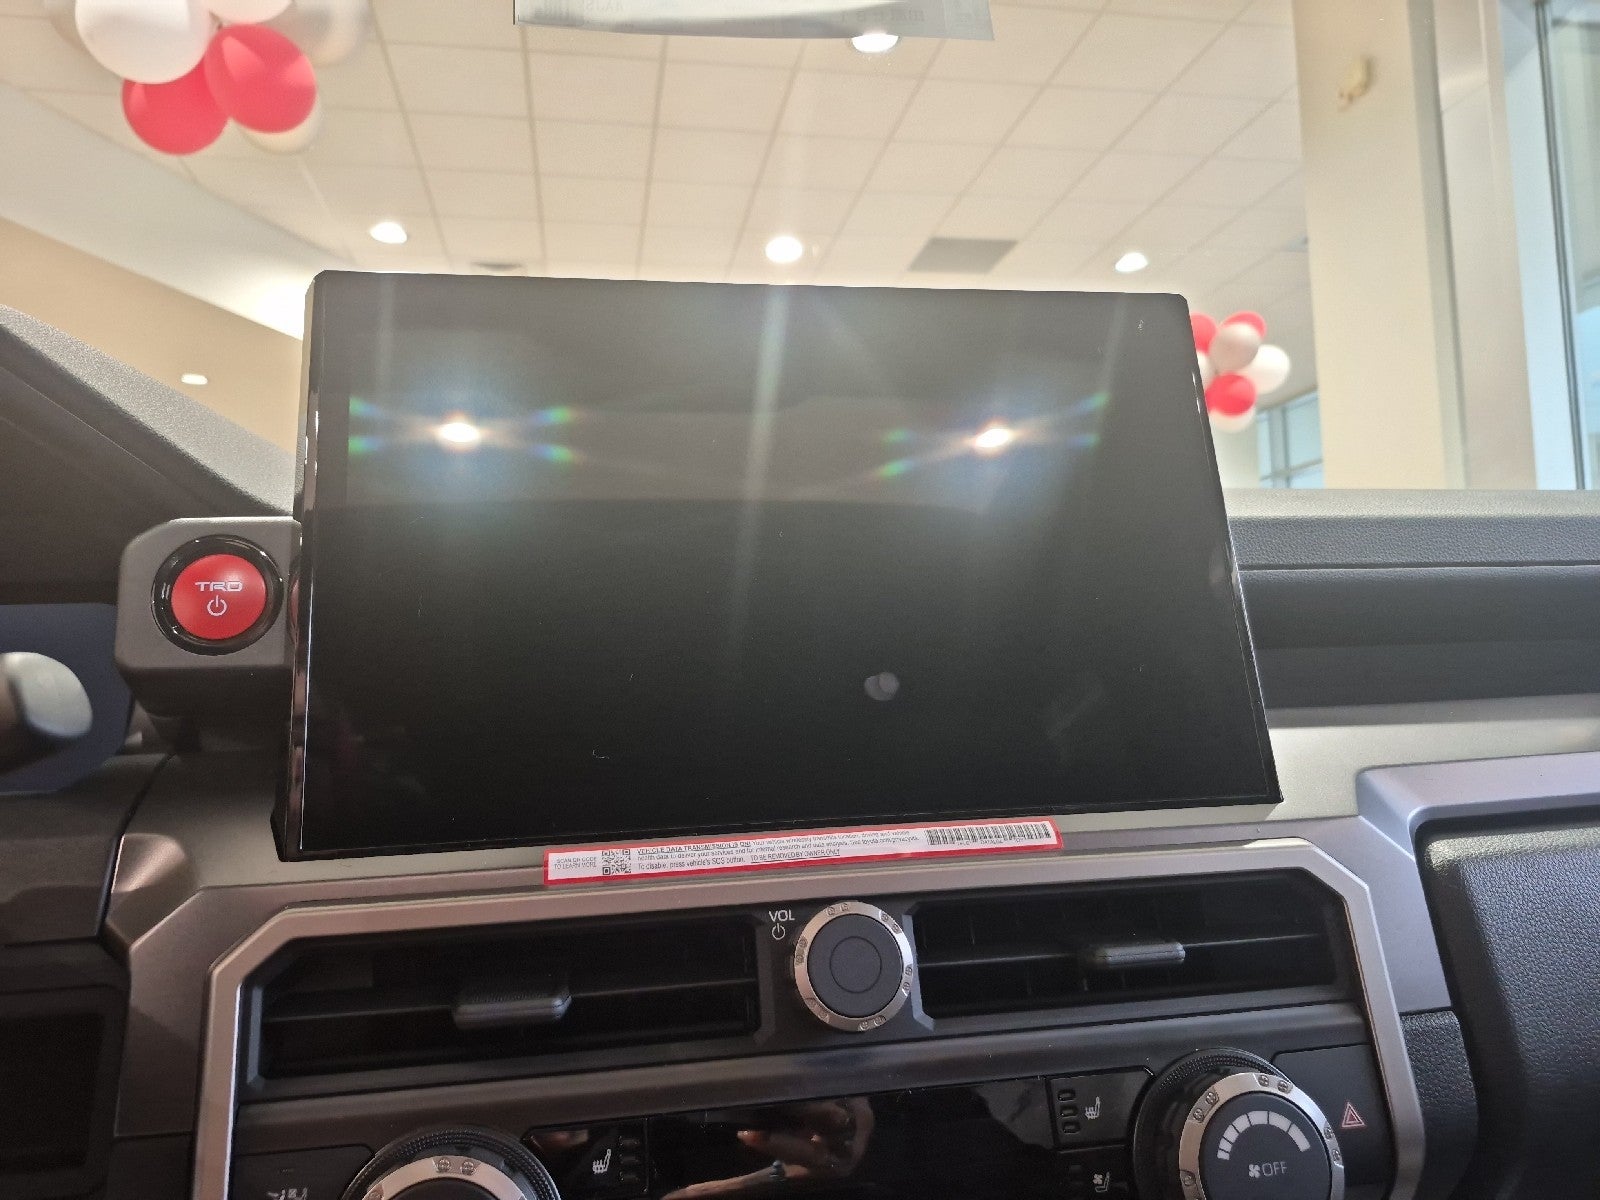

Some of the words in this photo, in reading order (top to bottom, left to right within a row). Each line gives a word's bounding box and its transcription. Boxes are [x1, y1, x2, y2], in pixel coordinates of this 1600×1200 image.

[195, 581, 243, 592] TRD
[768, 909, 796, 922] VOL
[1261, 1161, 1287, 1177] OFF
